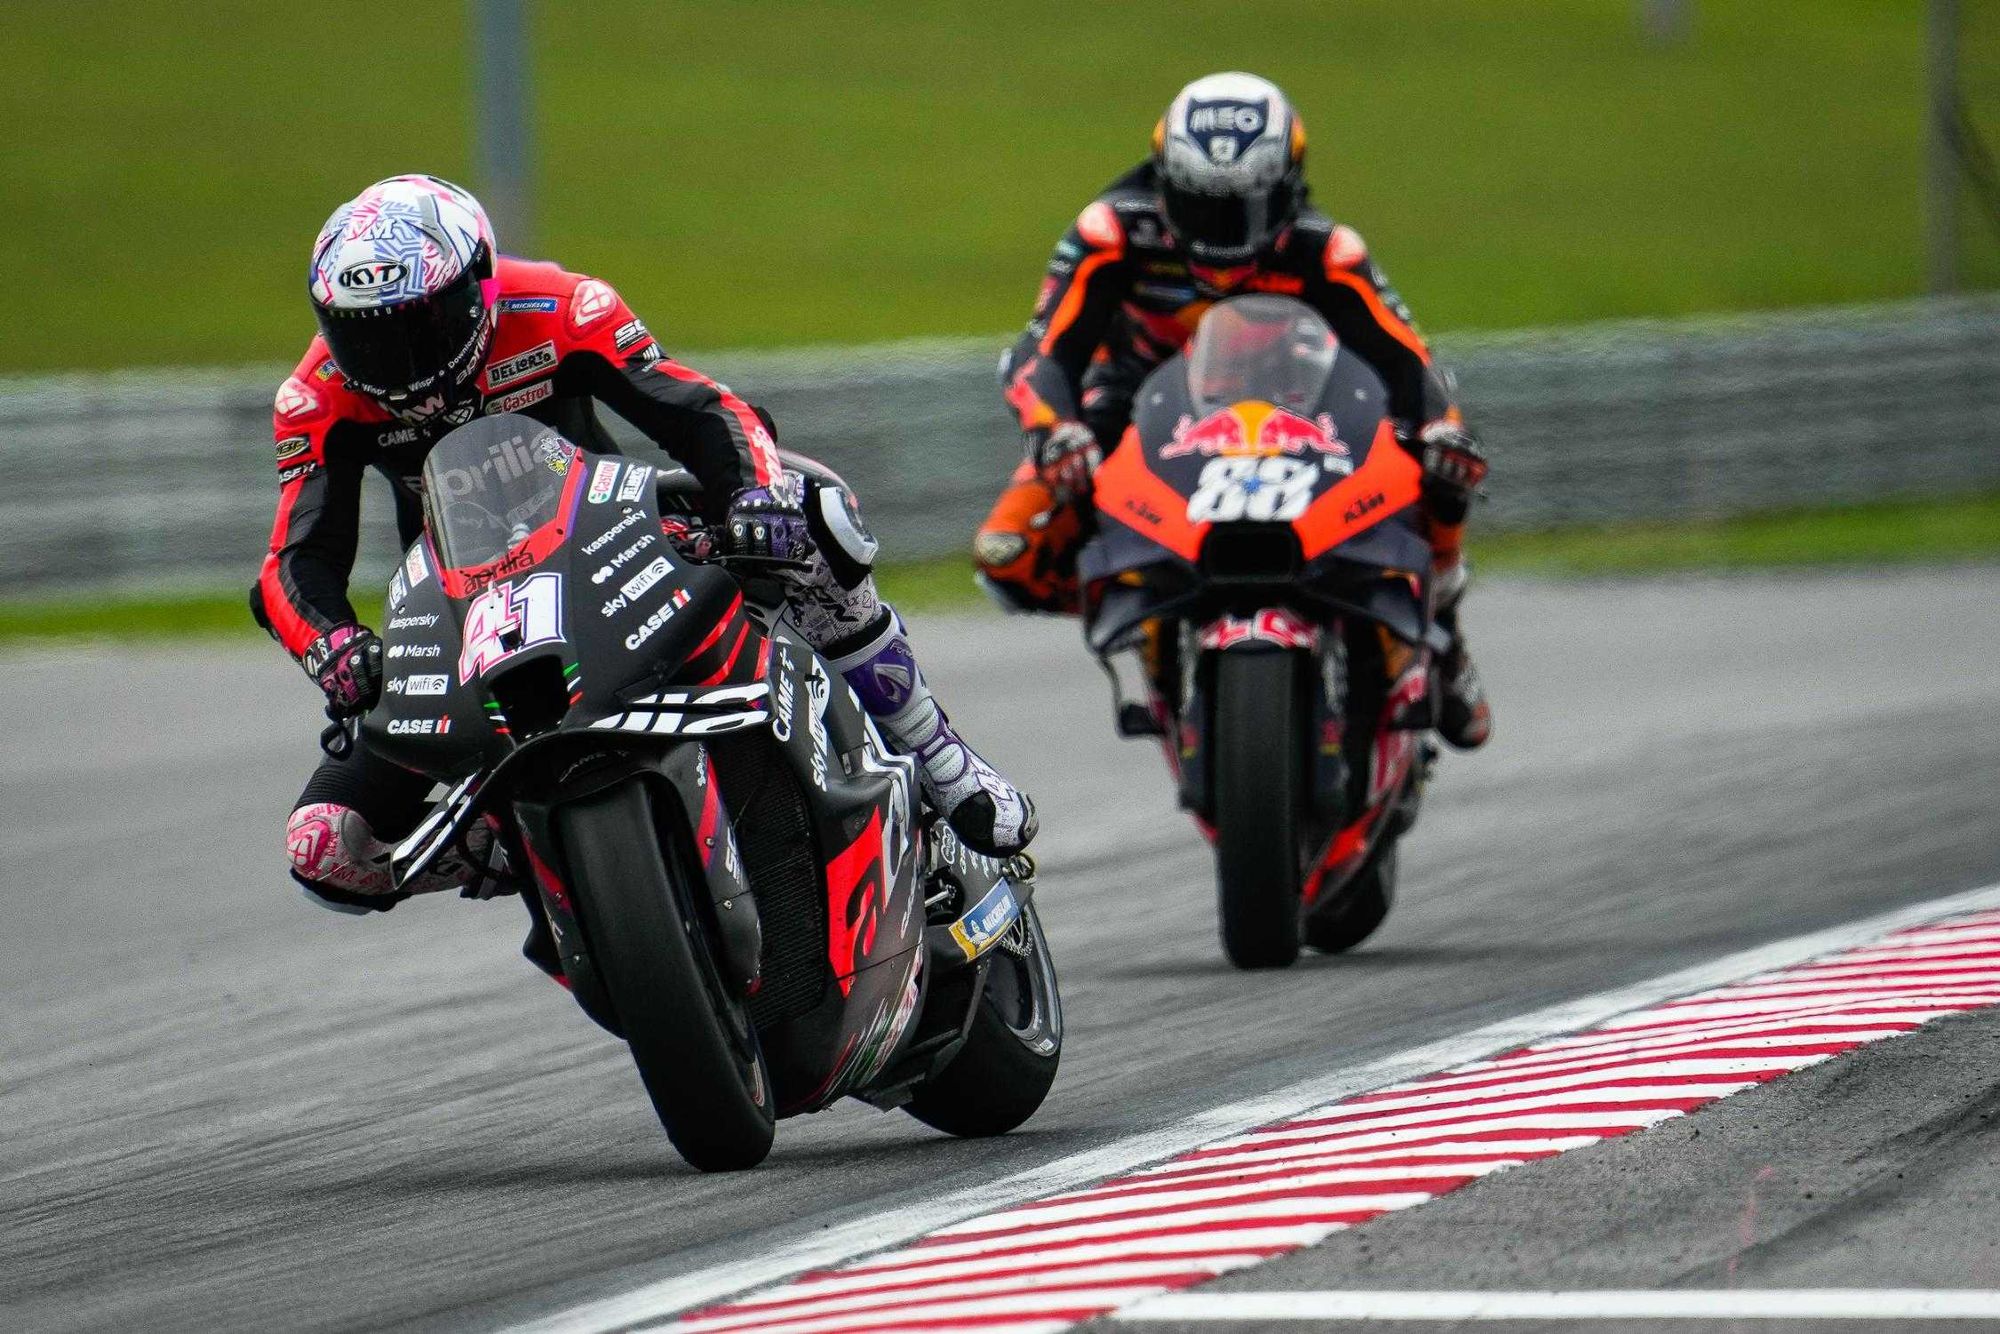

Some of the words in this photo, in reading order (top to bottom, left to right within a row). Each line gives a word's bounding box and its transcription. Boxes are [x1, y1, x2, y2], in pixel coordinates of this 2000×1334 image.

[407, 374, 436, 393] Wispr
[502, 382, 551, 413] Castrol
[376, 427, 419, 448] CAME
[580, 508, 648, 556] kaspersky
[609, 533, 656, 569] Marsh
[600, 593, 628, 618] sky
[626, 571, 654, 596] wifi
[387, 612, 441, 631] kaspersky
[457, 571, 568, 687] 41
[624, 602, 675, 651] CASE
[404, 644, 442, 659] Marsh
[386, 676, 407, 694] sky
[409, 679, 433, 691] wifi
[772, 664, 796, 742] CAME
[386, 718, 434, 735] CASE
